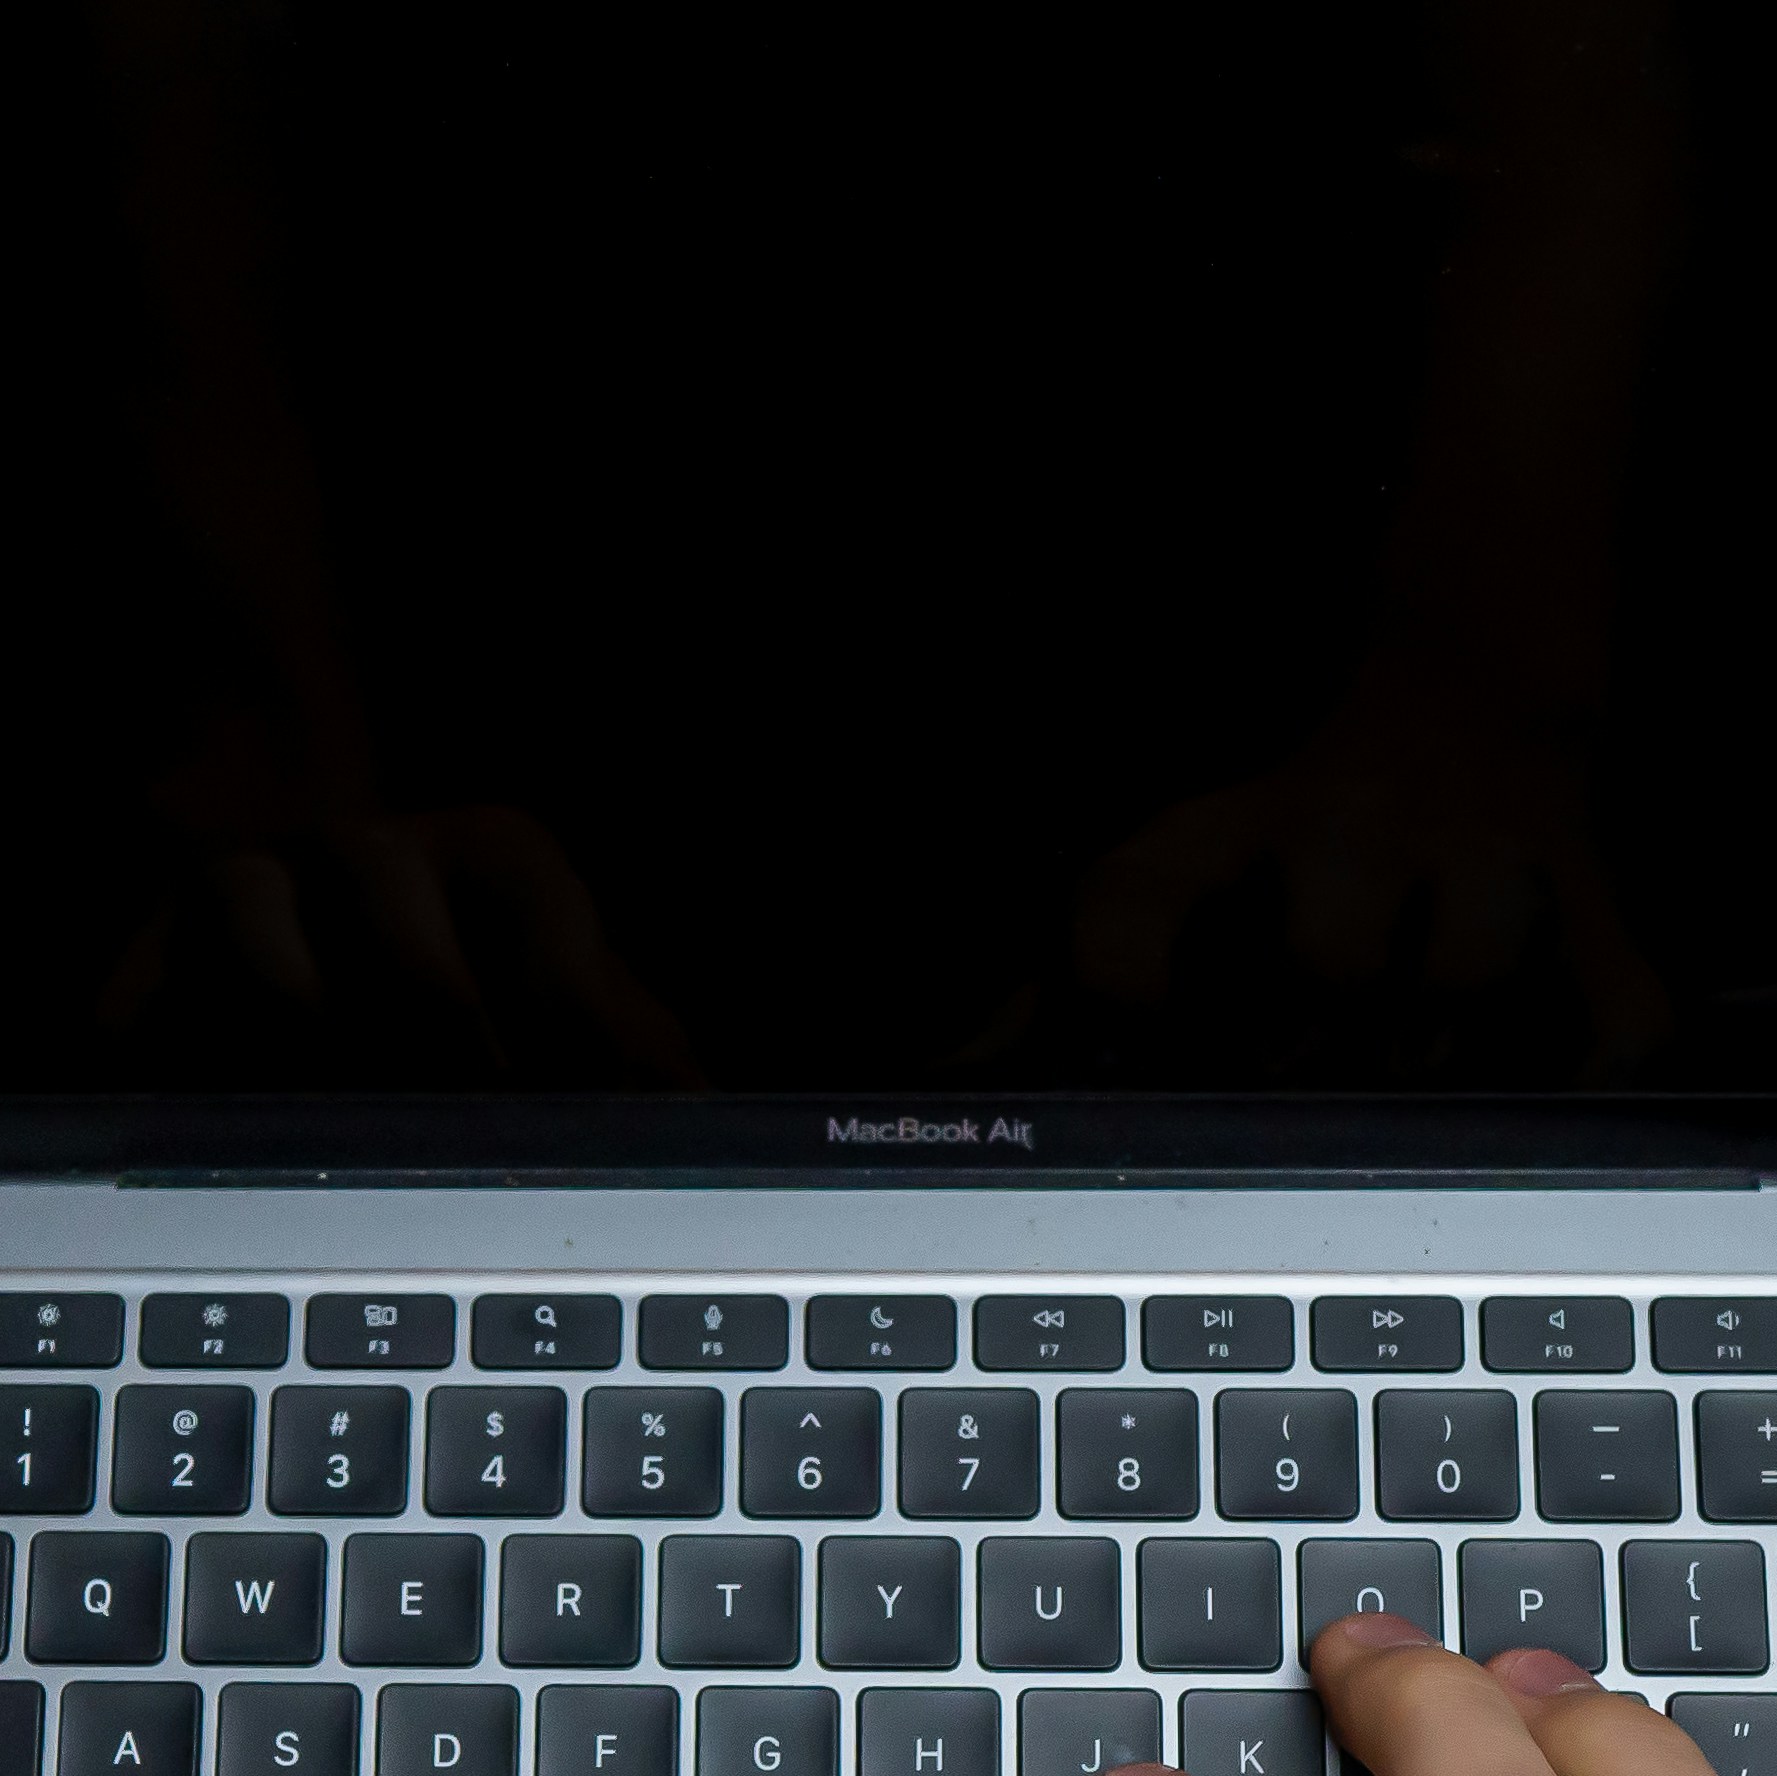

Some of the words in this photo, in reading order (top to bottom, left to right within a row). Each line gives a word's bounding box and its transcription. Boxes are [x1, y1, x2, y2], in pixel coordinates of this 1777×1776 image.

[827, 1117, 979, 1143] MacBook
[988, 1117, 1032, 1145] Air
[870, 1342, 892, 1356] F6
[1039, 1343, 1060, 1358] F7
[1378, 1344, 1398, 1358] F9
[1545, 1344, 1574, 1359] F10
[1717, 1345, 1742, 1359] F11
[23, 1407, 31, 1437] !
[172, 1409, 199, 1436] @
[329, 1411, 350, 1437] #
[486, 1410, 504, 1438] $
[641, 1412, 666, 1437] %
[957, 1414, 979, 1440] &
[1282, 1414, 1290, 1441] (
[1444, 1415, 1452, 1442] )
[17, 1452, 32, 1486] 1
[171, 1452, 195, 1487] 2
[326, 1453, 350, 1489] 3
[481, 1455, 507, 1488] 4
[641, 1455, 665, 1490] 5
[797, 1456, 823, 1490] 6
[958, 1457, 980, 1491] 7
[1117, 1457, 1141, 1491] 8
[1275, 1457, 1300, 1492] 9
[1436, 1459, 1461, 1493] 0
[84, 1578, 112, 1617] Q
[235, 1580, 276, 1614] W
[1686, 1561, 1702, 1601] {
[400, 1581, 424, 1616] E
[556, 1582, 582, 1617] R
[715, 1583, 743, 1617] T
[877, 1584, 903, 1619] Y
[1035, 1585, 1063, 1620] U
[1206, 1586, 1213, 1621] I
[1519, 1588, 1544, 1623] P
[1689, 1615, 1703, 1652] [
[112, 1730, 141, 1765] A
[273, 1730, 300, 1767] S
[433, 1733, 461, 1768] D
[595, 1734, 618, 1768] F
[753, 1735, 781, 1771] G
[915, 1737, 943, 1772] H
[1081, 1738, 1101, 1773] J
[1239, 1740, 1265, 1774] K
